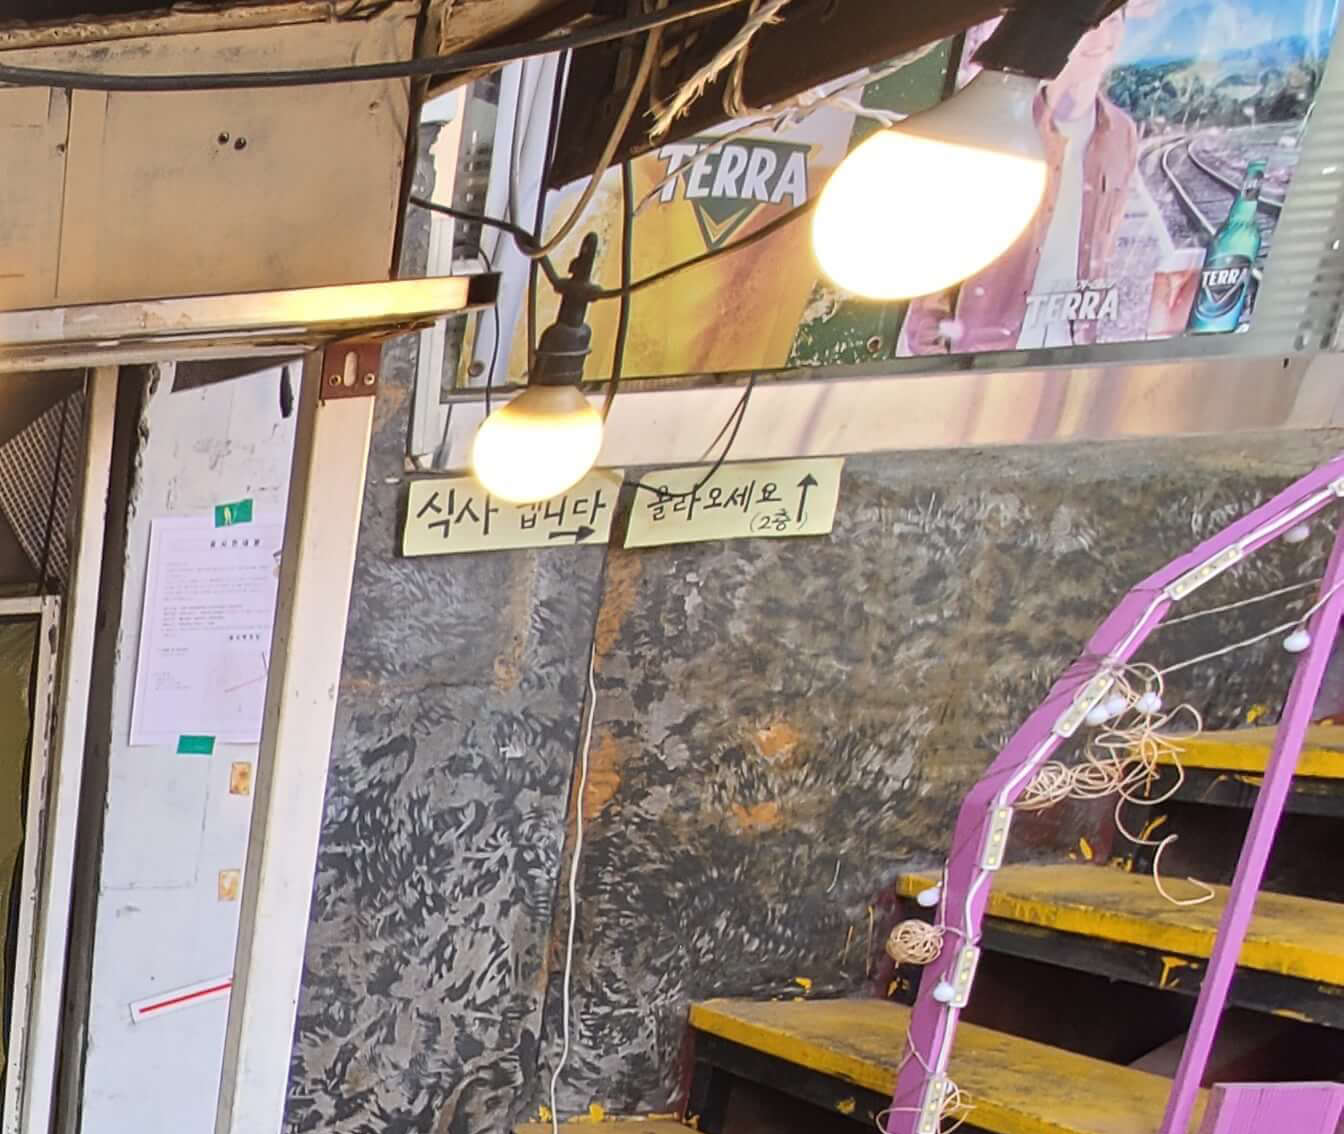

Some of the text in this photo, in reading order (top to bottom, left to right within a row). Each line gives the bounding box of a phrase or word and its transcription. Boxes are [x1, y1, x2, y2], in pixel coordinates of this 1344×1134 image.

[659, 141, 808, 208] TERRA
[1201, 268, 1248, 289] TERRA
[1025, 288, 1120, 324] TERRA
[416, 487, 499, 538] 식사
[647, 480, 782, 521] 올라오세요
